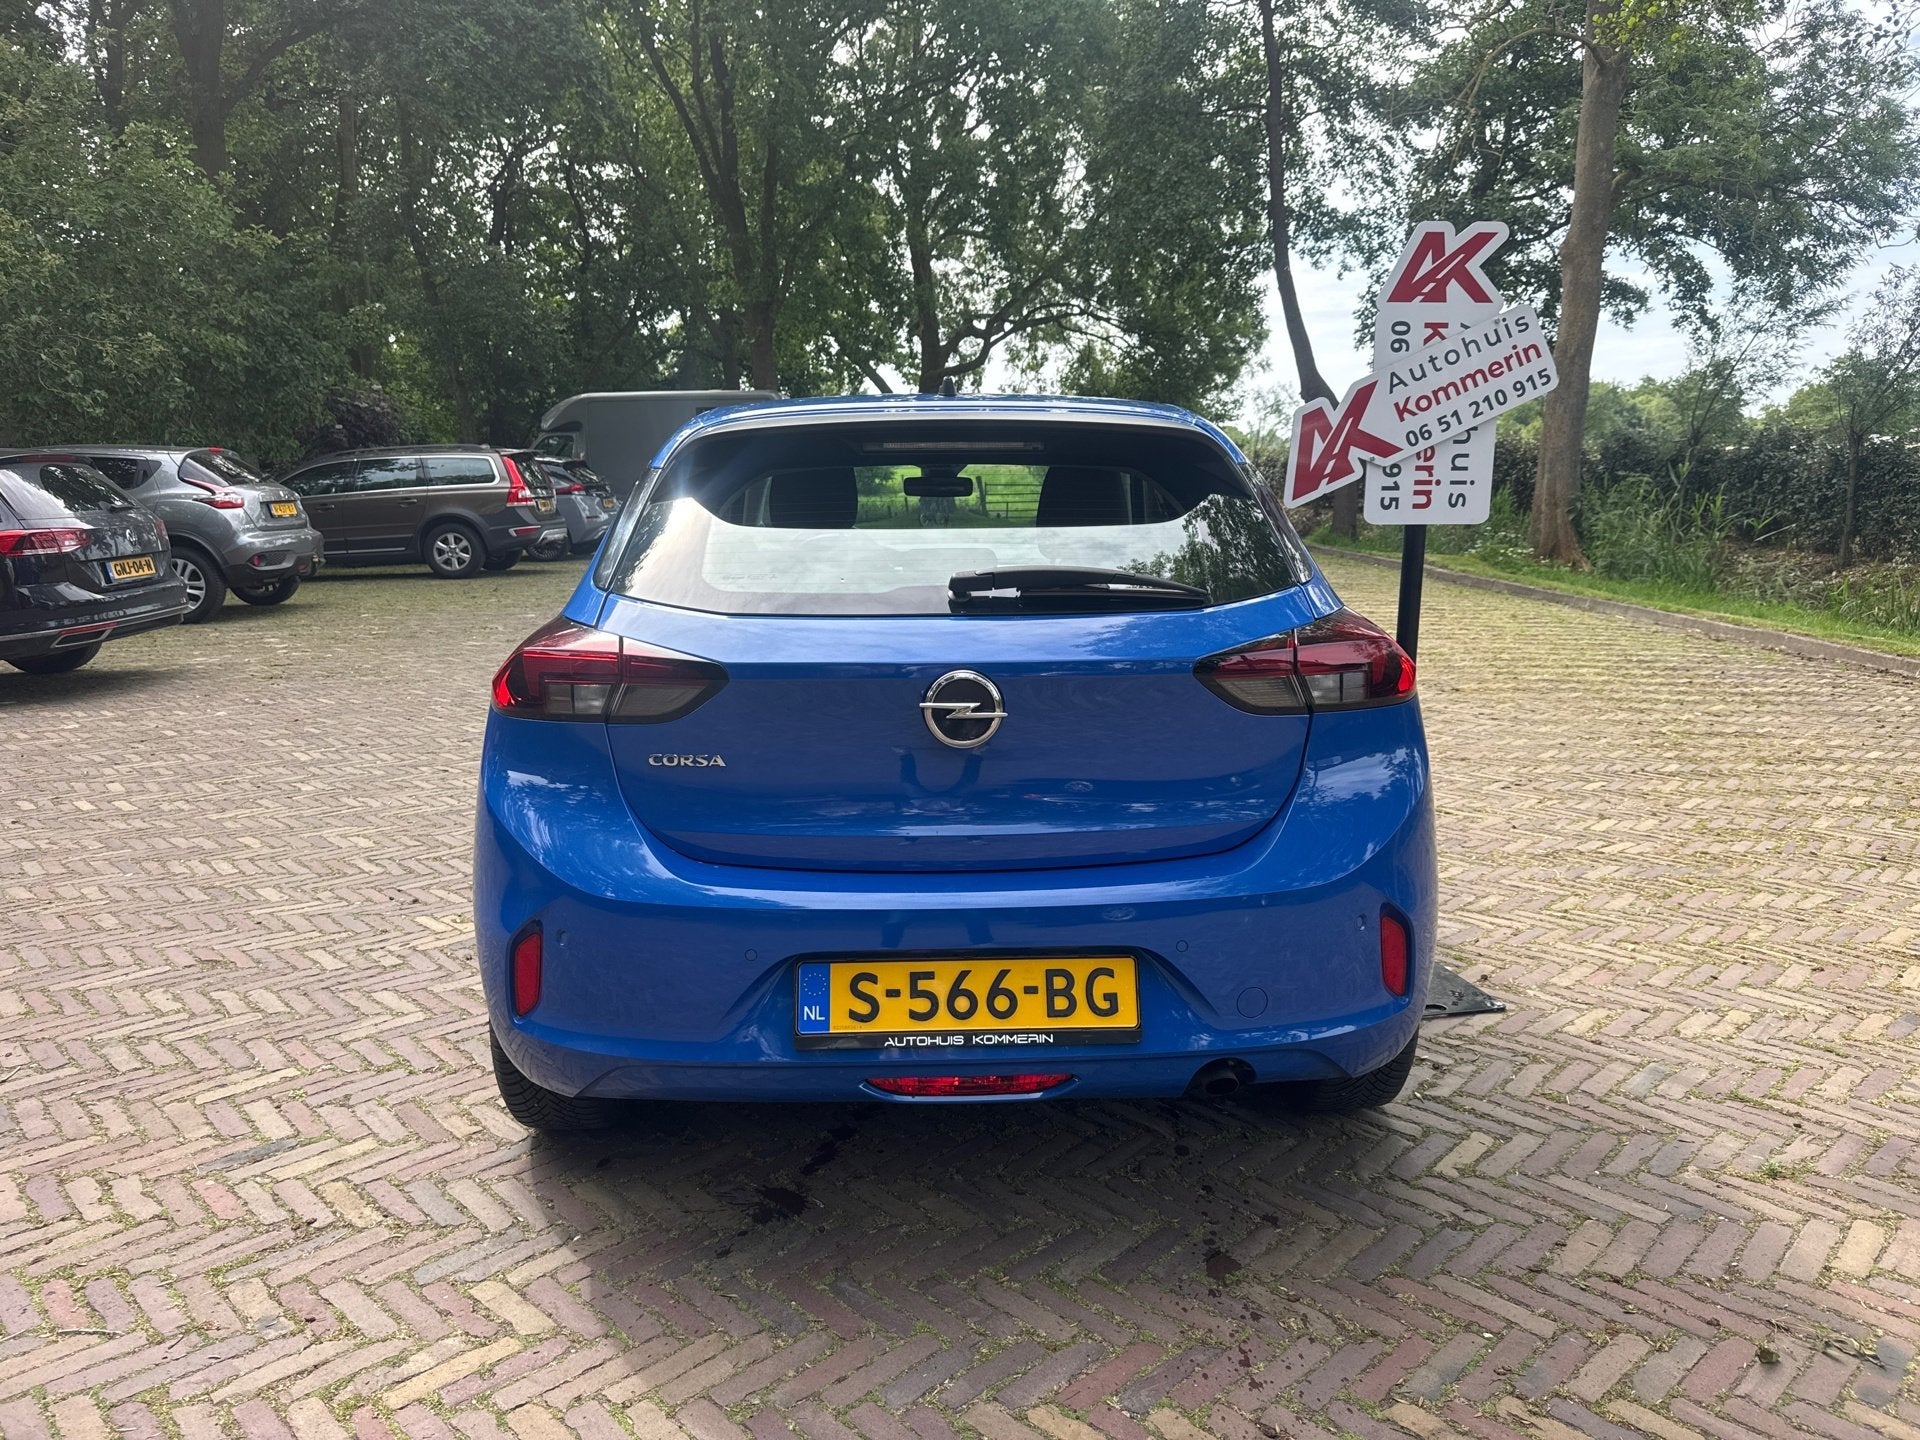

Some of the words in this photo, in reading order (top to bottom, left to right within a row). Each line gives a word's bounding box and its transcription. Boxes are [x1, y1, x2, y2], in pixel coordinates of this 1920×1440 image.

[1389, 315, 1530, 395] Autohuis
[1390, 320, 1411, 353] 06
[1393, 343, 1543, 423] Kommerin
[1405, 423, 1433, 447] 06
[1437, 410, 1463, 433] 51
[1468, 388, 1508, 419] 210
[1512, 367, 1551, 398] 915
[1380, 463, 1402, 511] 915
[648, 753, 727, 767] CORSA
[803, 1005, 826, 1022] NL
[848, 967, 1120, 1024] S-566-BG
[884, 1034, 965, 1047] AUTOHUIS
[972, 1033, 1054, 1045] KOMMERIN
